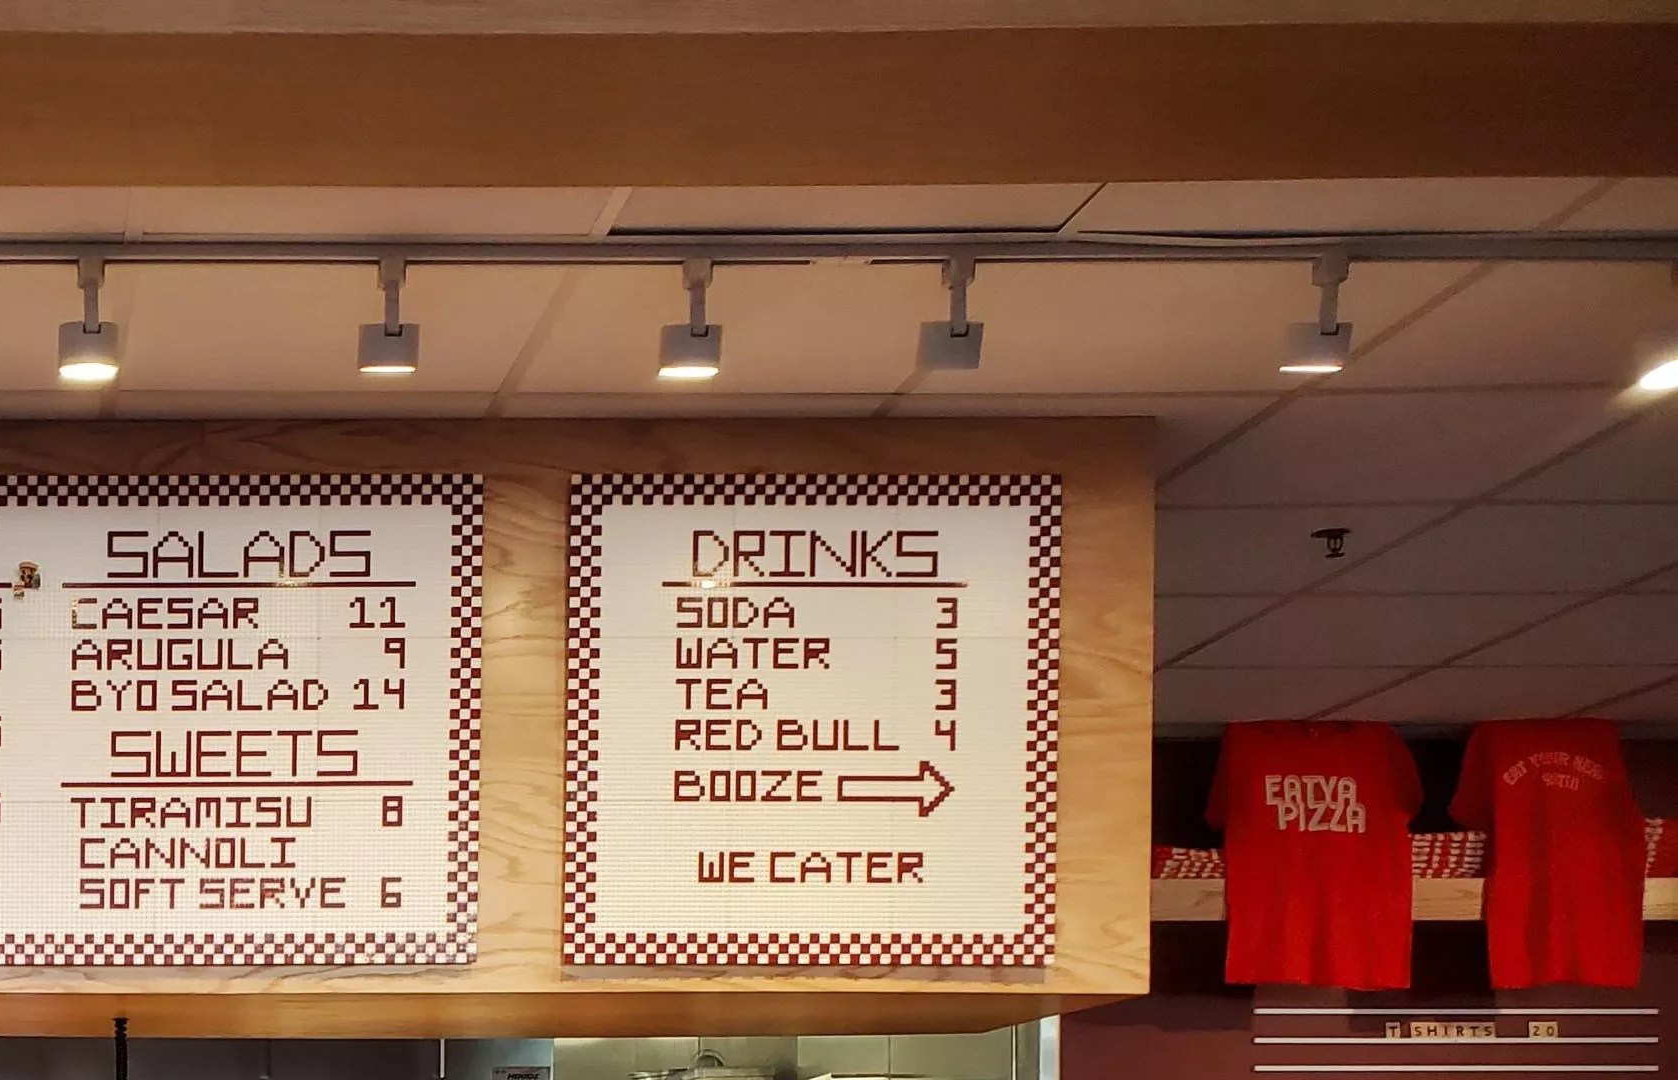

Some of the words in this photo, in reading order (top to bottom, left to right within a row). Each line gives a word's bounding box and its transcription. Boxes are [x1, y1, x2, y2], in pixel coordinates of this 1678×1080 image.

[106, 530, 372, 578] SALADS
[692, 530, 939, 577] DRINKS
[72, 598, 258, 629] CAESAR
[350, 597, 405, 628] 11
[677, 597, 794, 628] SODA
[937, 598, 957, 628] 3
[72, 639, 288, 670] ARUGULA
[385, 638, 405, 668] 9
[676, 638, 829, 669] WATER
[936, 639, 957, 669] 5
[72, 680, 157, 711] BYO
[172, 679, 328, 711] SALAD
[354, 679, 404, 710] 14
[676, 679, 767, 709] TEA
[935, 679, 956, 710] 3
[675, 720, 762, 750] RED
[777, 720, 899, 751] BULL
[935, 720, 956, 751] 4
[110, 730, 358, 777] SWEETS
[674, 771, 822, 802] BOOZE
[71, 797, 311, 828] TIRAMISU
[382, 796, 403, 827] 8
[1278, 799, 1367, 834] PIZZA
[80, 837, 296, 868] CANNOLI
[698, 852, 755, 883] WE
[770, 852, 923, 883] CATER
[80, 878, 185, 909] SOFT
[200, 877, 346, 909] SERVE
[381, 877, 401, 908] 6
[1414, 1025, 1493, 1038] SHIRTS
[1532, 1025, 1556, 1037] 20
